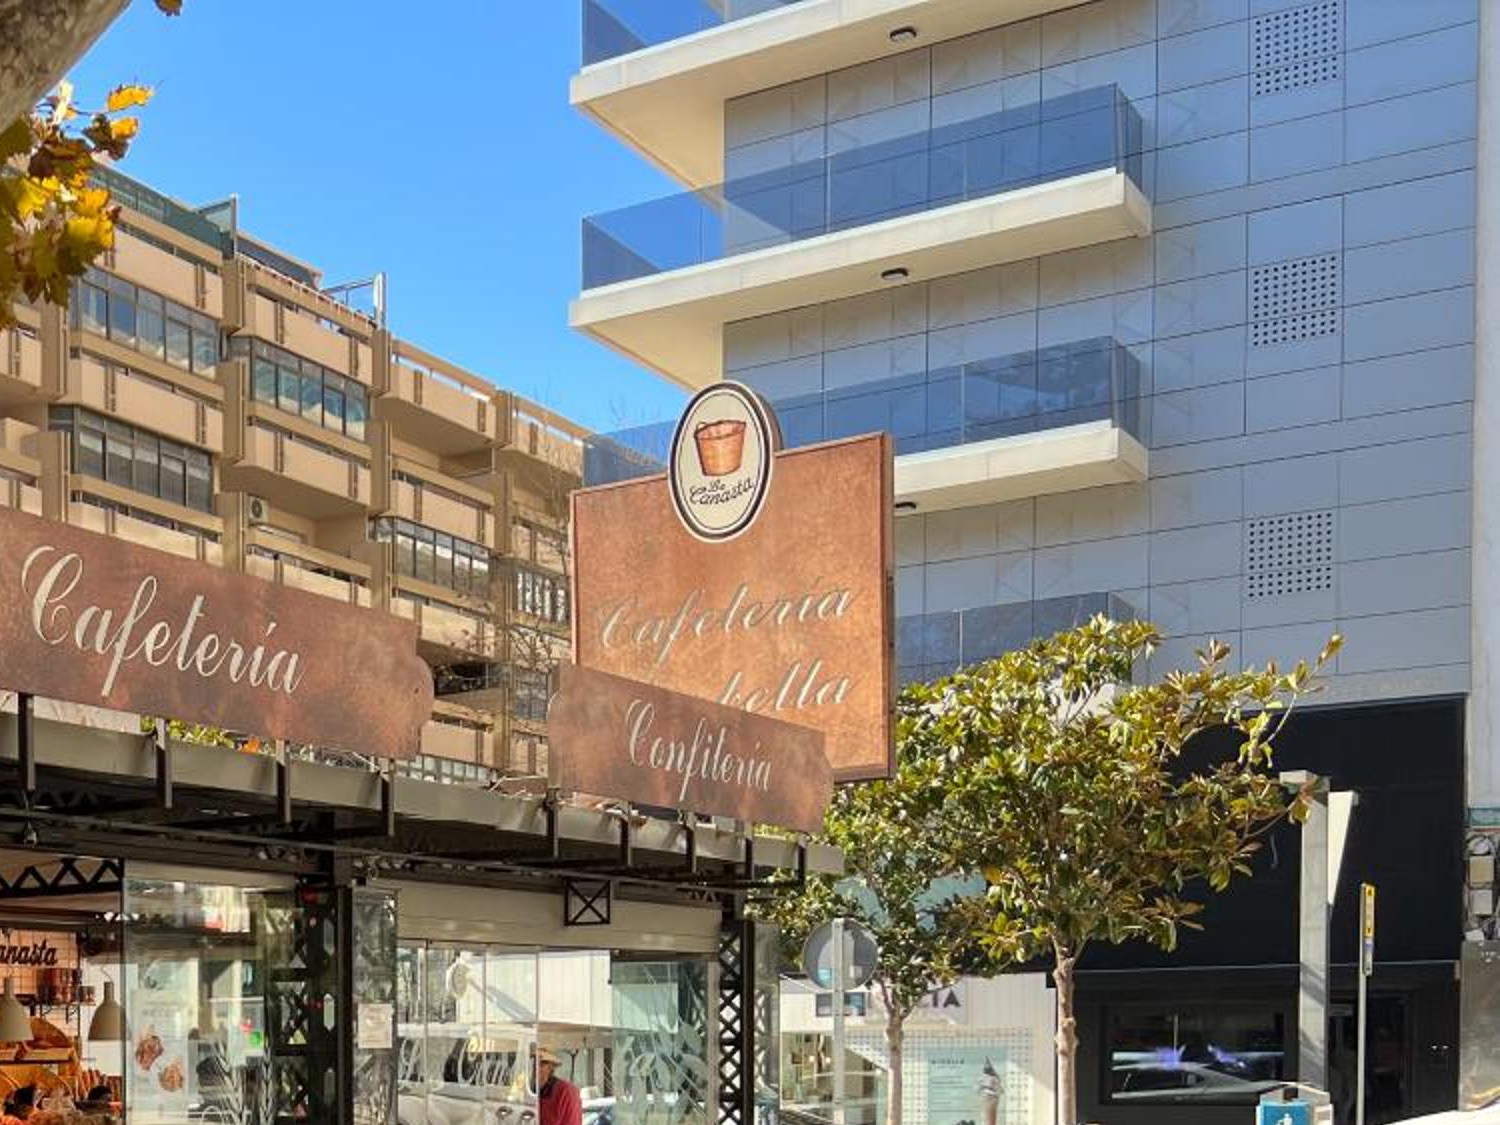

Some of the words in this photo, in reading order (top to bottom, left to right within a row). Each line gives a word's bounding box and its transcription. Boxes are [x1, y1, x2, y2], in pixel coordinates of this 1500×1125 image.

[20, 544, 308, 698] Cafetería
[598, 577, 855, 665] Cafetería
[624, 698, 774, 802] Confitería
